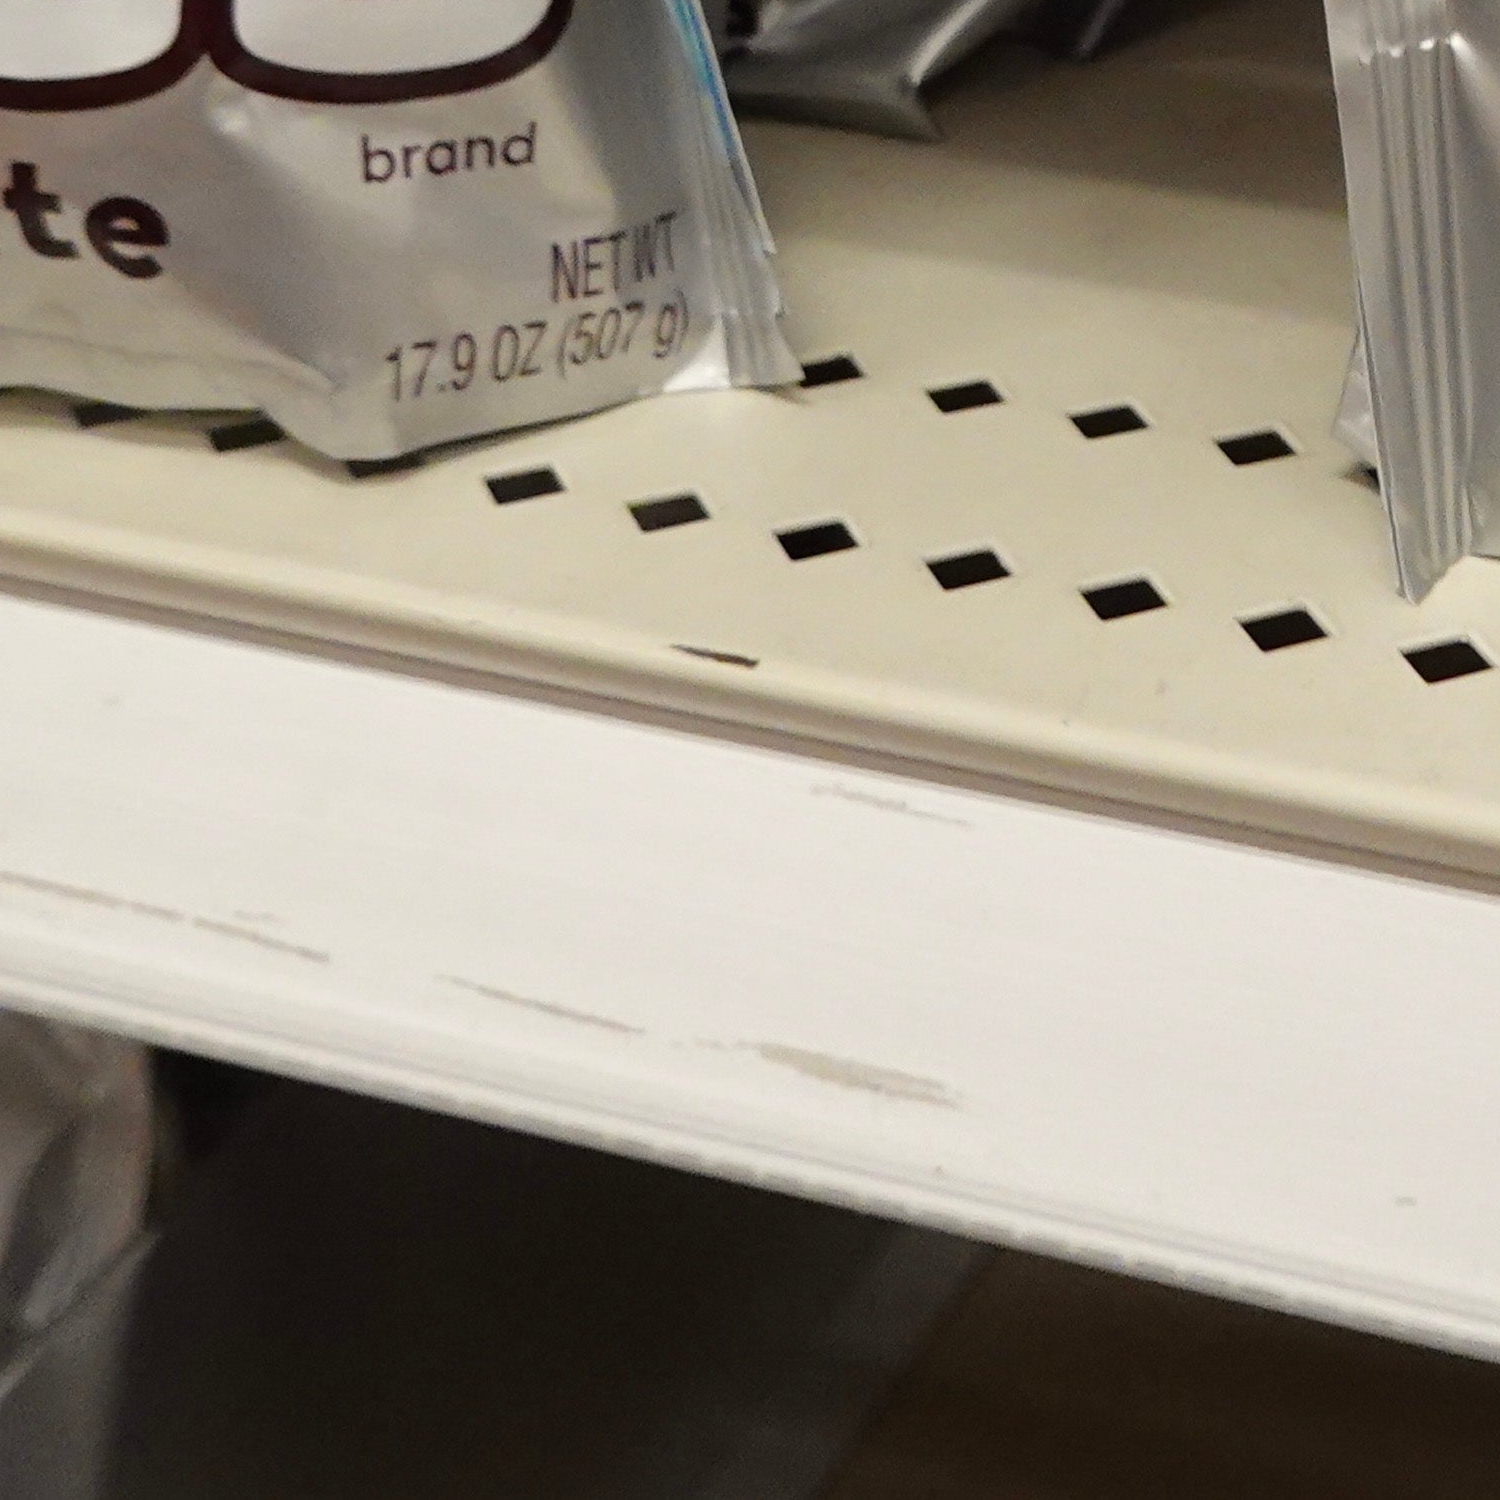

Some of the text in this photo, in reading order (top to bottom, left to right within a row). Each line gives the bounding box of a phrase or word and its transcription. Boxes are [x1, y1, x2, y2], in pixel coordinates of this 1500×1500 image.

[360, 119, 538, 184] brand
[551, 229, 627, 304] NET
[385, 287, 690, 402] 17.9 OZ (507 g)
